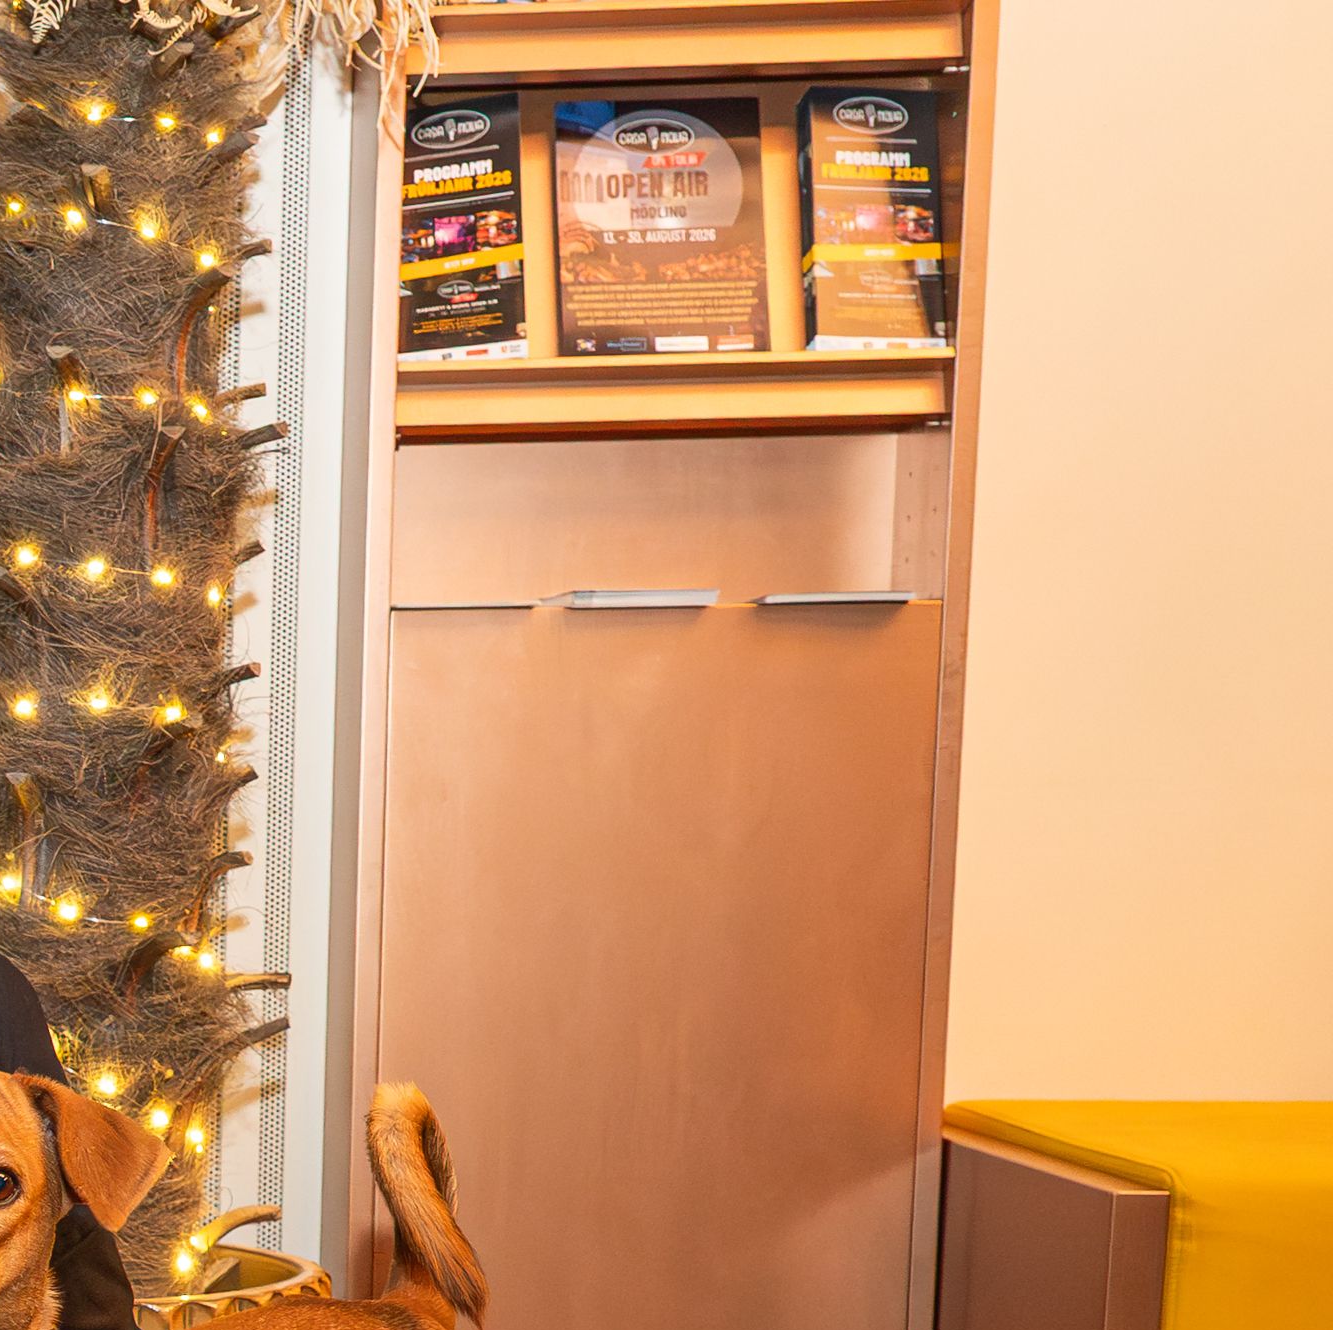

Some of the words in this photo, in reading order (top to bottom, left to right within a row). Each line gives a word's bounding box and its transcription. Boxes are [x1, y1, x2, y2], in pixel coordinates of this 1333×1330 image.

[835, 150, 911, 168] PROGRAMM
[413, 158, 493, 184] PROGRAMM
[474, 169, 513, 190] 2026
[606, 172, 664, 200] OPEN
[672, 170, 709, 197] AIR
[630, 203, 688, 220] MÖDLING
[645, 228, 687, 244] AUGUST
[688, 227, 717, 242] 2026
